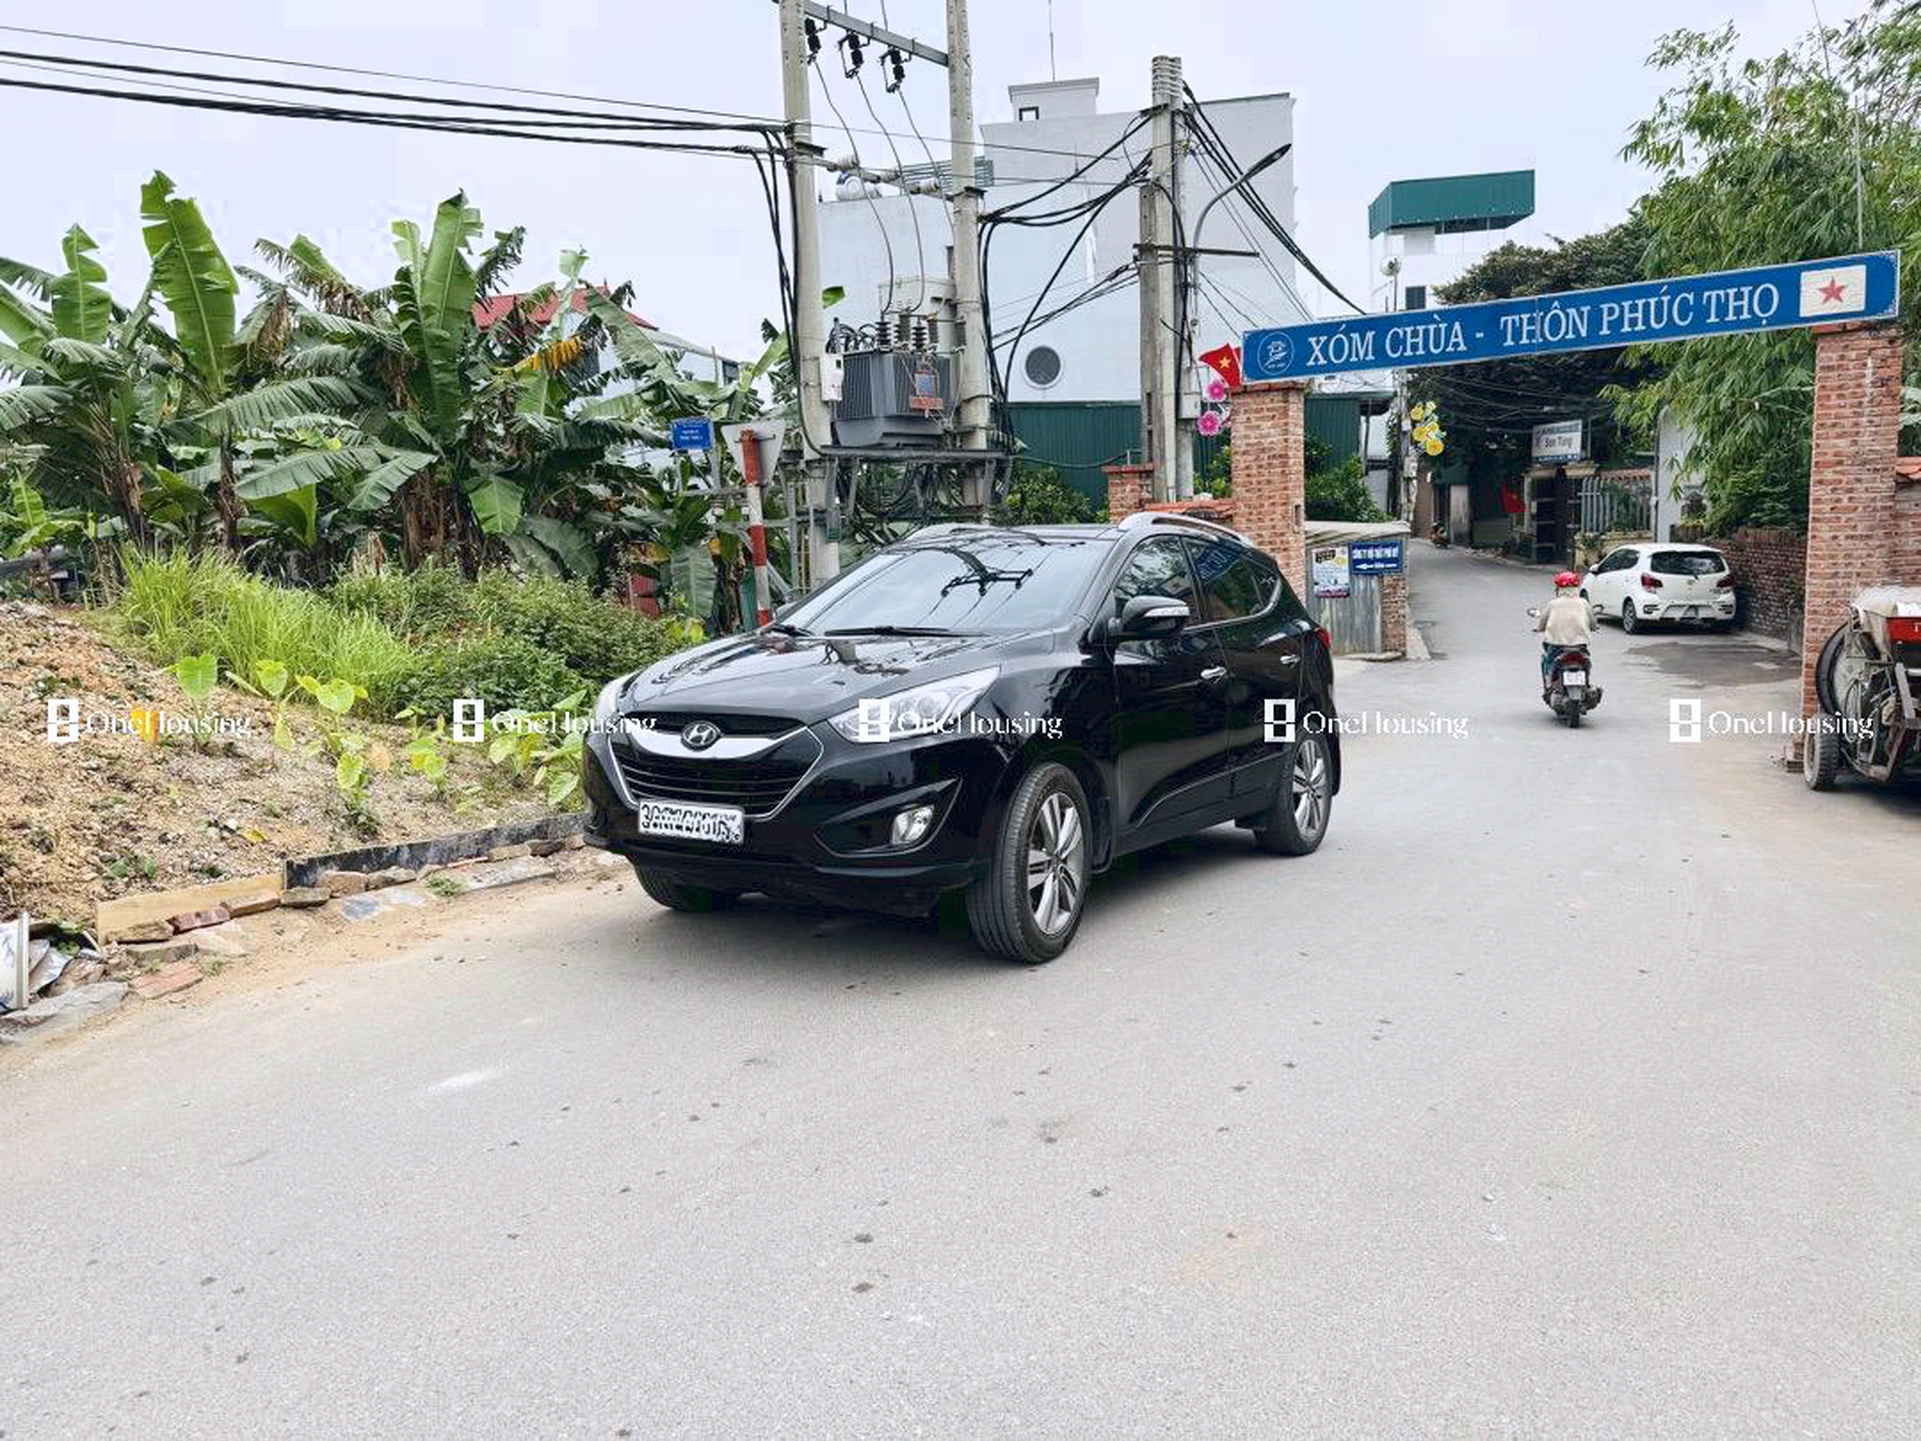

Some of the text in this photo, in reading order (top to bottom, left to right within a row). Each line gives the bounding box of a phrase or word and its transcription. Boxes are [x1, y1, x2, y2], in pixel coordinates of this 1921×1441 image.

[1306, 324, 1376, 366] XÓM
[1385, 313, 1467, 358] CHÙA
[1500, 300, 1592, 347] THÔN
[1599, 285, 1695, 336] PHÚC
[1702, 282, 1780, 326] THỌ
